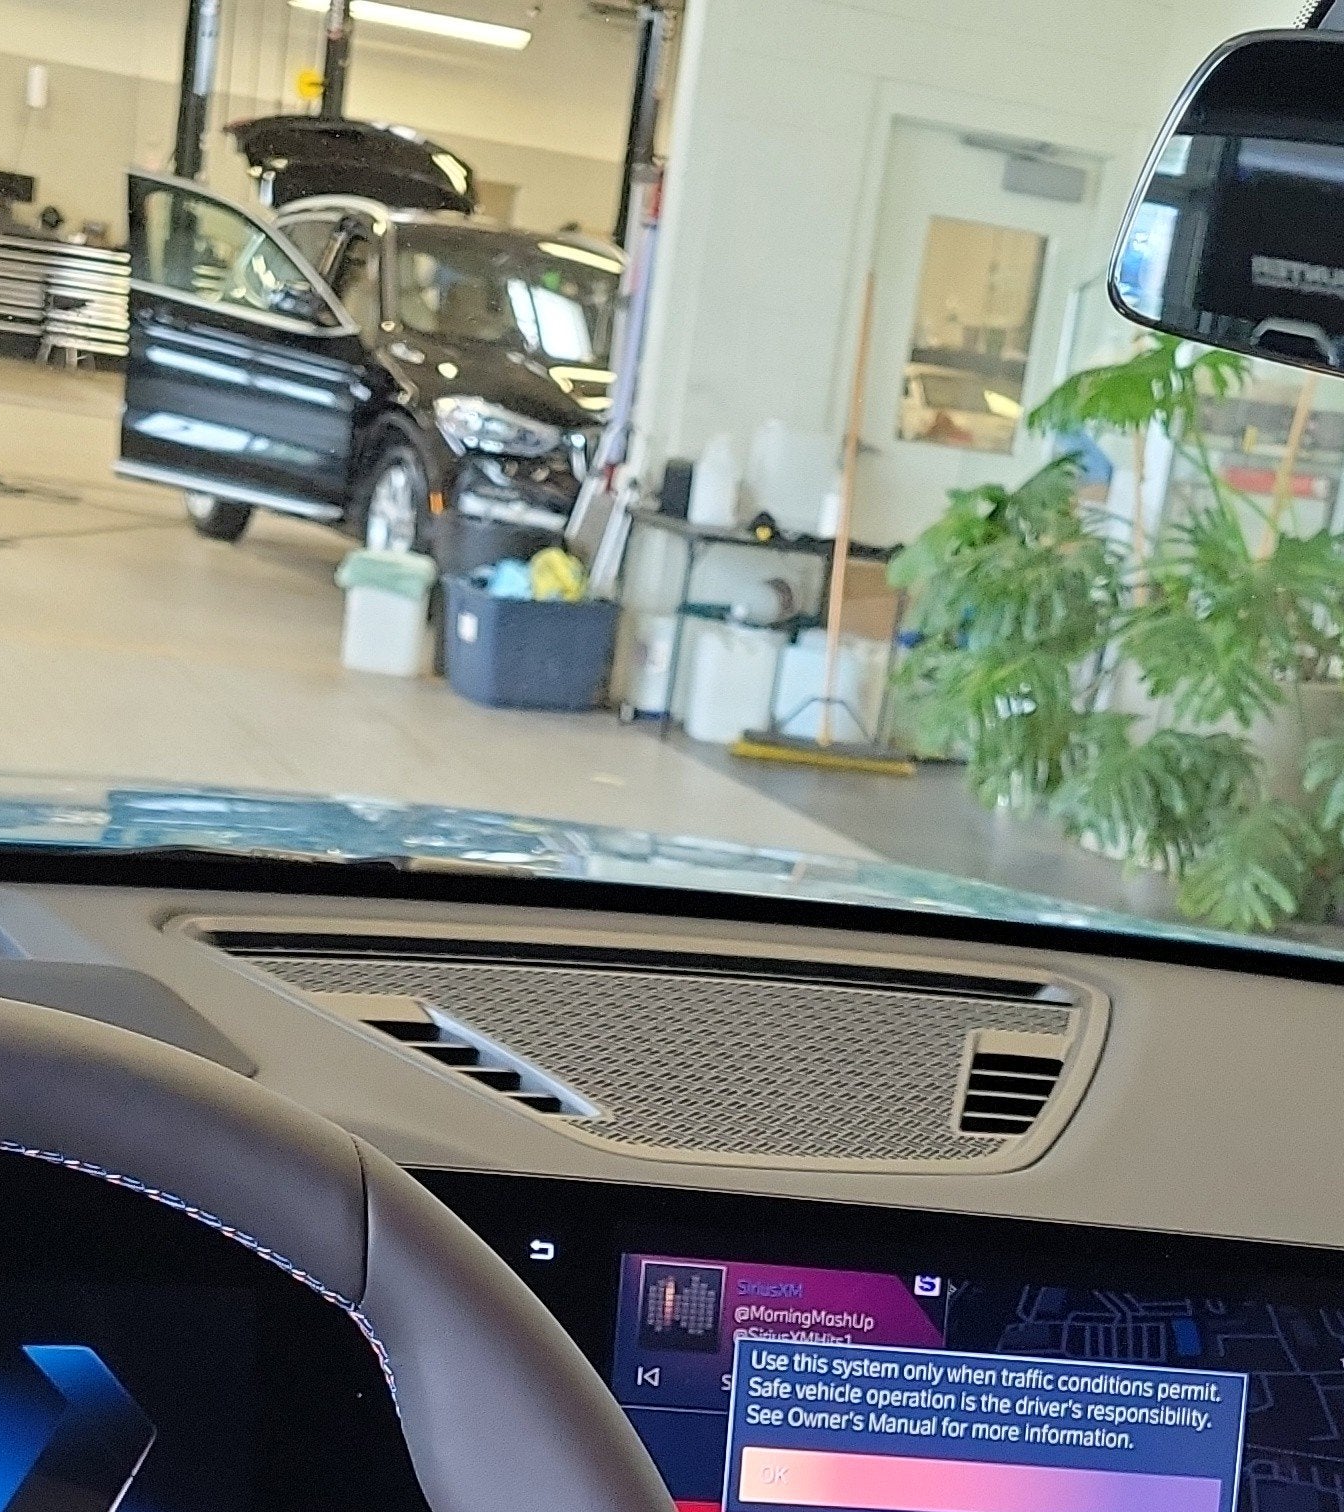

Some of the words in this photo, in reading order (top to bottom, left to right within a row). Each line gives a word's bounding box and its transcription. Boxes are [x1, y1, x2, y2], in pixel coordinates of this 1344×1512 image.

[737, 1279, 805, 1299] SiriusXM
[734, 1304, 874, 1332] @MorningMashUp
[751, 1349, 789, 1371] Use
[793, 1352, 828, 1374] this
[832, 1358, 899, 1381] system
[903, 1361, 944, 1386] only
[947, 1363, 996, 1386] when
[1001, 1367, 1055, 1391] traffic
[1057, 1373, 1154, 1398] conditions
[1157, 1382, 1223, 1403] permit.
[748, 1376, 792, 1400] Safe
[795, 1380, 863, 1404] vehicle
[866, 1388, 956, 1412] operation
[960, 1393, 976, 1412] is
[980, 1395, 1012, 1414] the
[1015, 1396, 1083, 1419] driver's
[1087, 1403, 1213, 1432] responsibility.
[746, 1404, 784, 1427] See
[787, 1406, 864, 1432] Owner's
[868, 1412, 937, 1436] Manual
[941, 1415, 967, 1438] for
[971, 1422, 1020, 1442] more
[1024, 1422, 1135, 1450] information.
[761, 1466, 789, 1484] OK
